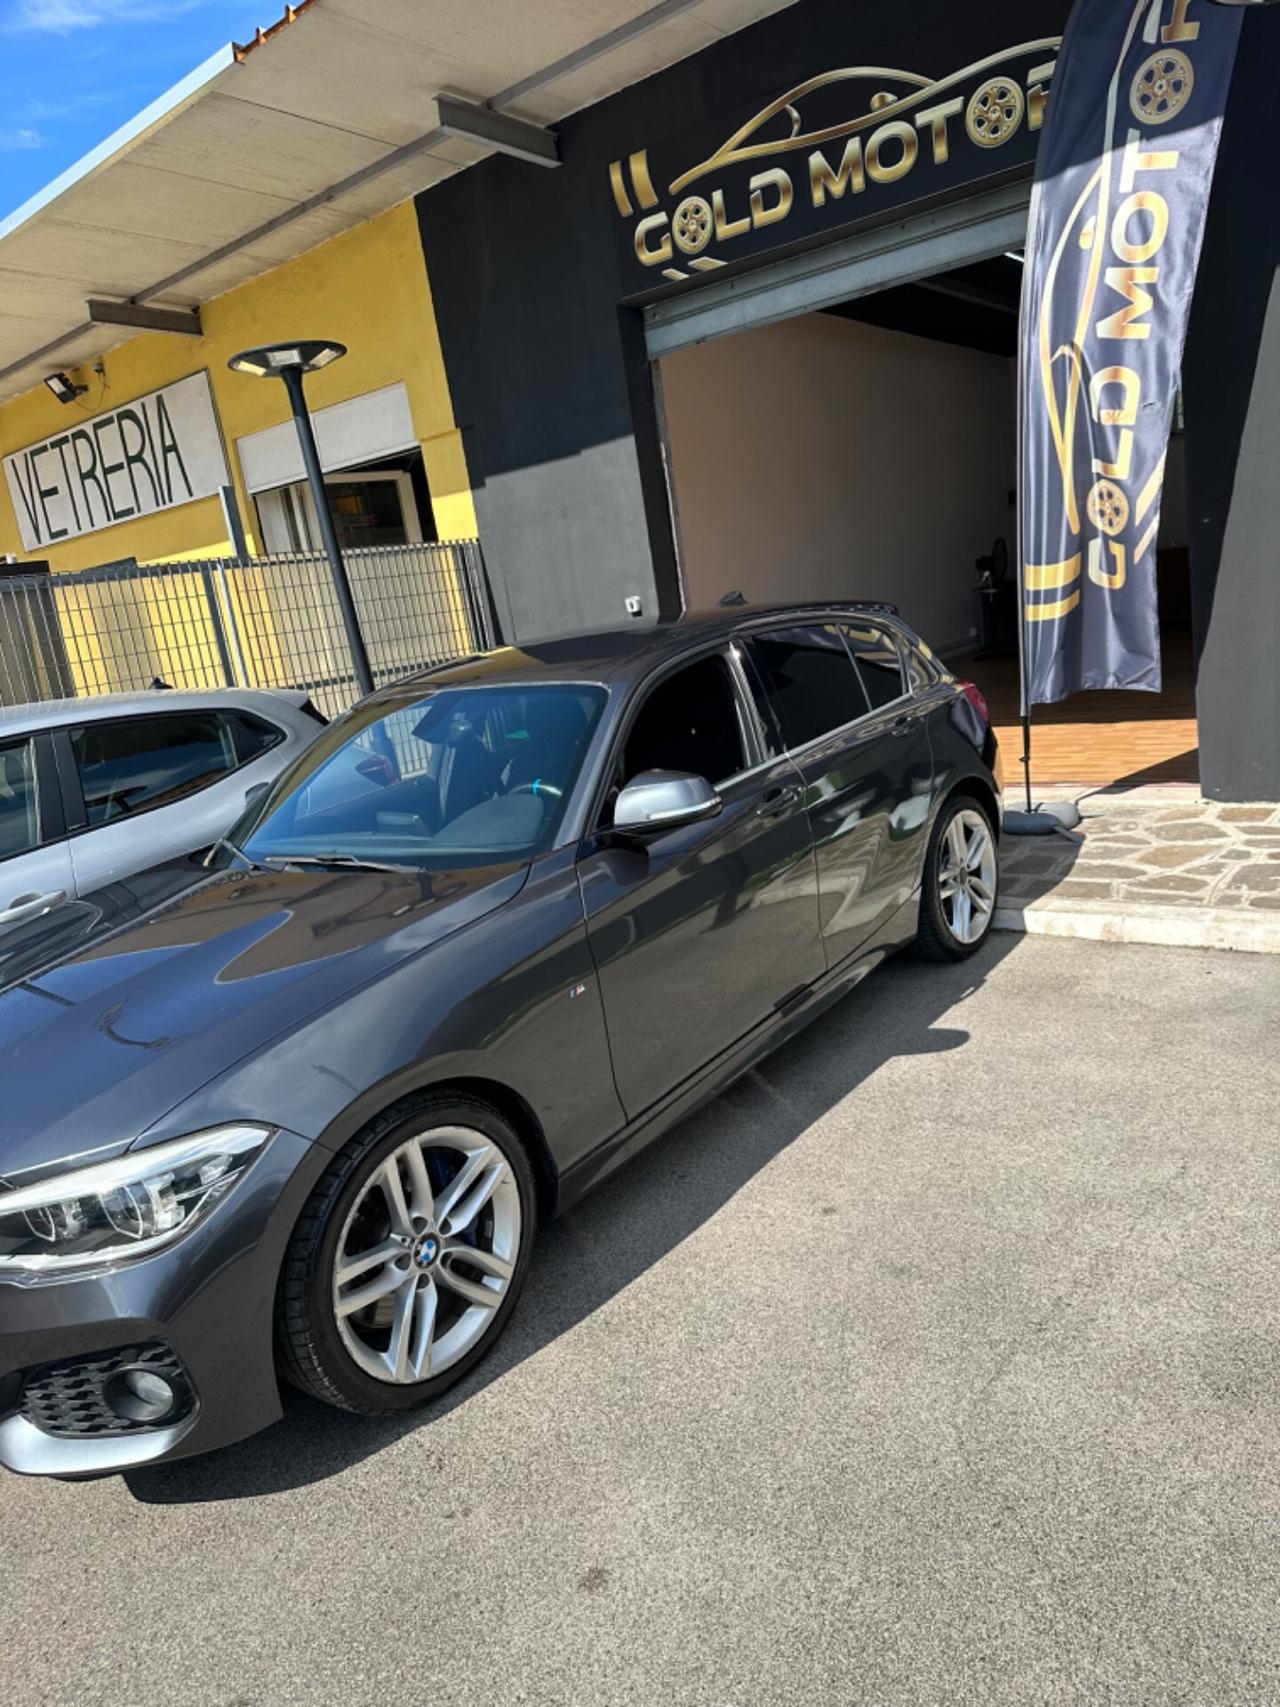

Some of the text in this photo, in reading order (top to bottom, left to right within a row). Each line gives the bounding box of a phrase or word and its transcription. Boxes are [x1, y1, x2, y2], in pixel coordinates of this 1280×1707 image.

[634, 167, 793, 268] GOLD
[11, 394, 194, 545] VETRERIA
[1086, 365, 1141, 590] GOLD
